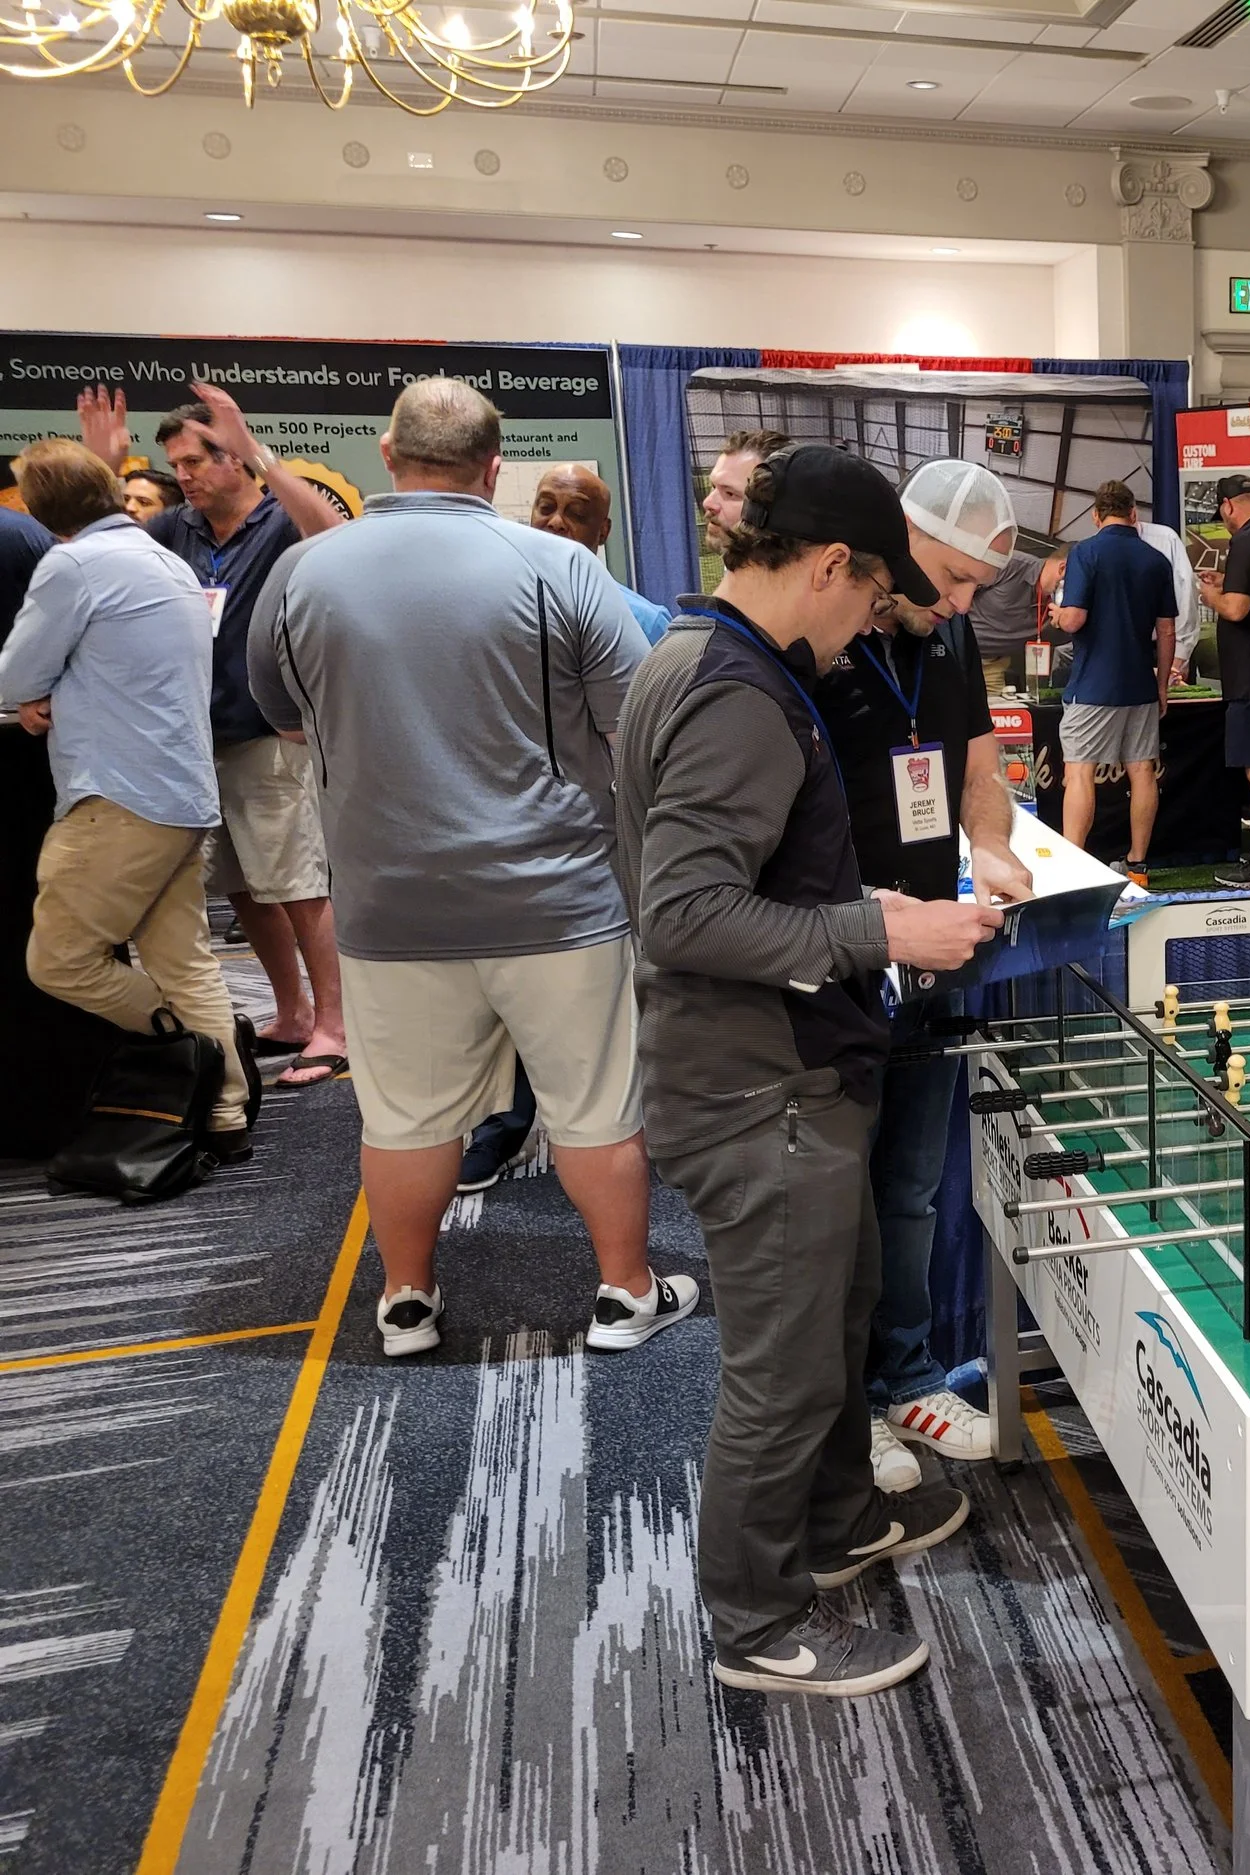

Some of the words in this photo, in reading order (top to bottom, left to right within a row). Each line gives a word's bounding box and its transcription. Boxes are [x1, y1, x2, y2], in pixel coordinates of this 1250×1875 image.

[9, 358, 125, 382] Someone
[128, 361, 186, 383] Who
[191, 362, 342, 386] Understands
[346, 371, 382, 387] our
[498, 370, 599, 396] Beverage
[245, 421, 273, 434] han
[279, 422, 308, 434] 500
[314, 423, 377, 438] Projects
[500, 433, 554, 443] estaurant
[557, 432, 578, 442] and
[268, 441, 330, 456] mpleted
[502, 447, 551, 457] emodels
[1183, 444, 1216, 457] CUSTOM
[910, 798, 936, 809] JEREMY
[912, 806, 936, 817] BRUCE
[1206, 914, 1247, 926] Cascadia
[1063, 1270, 1100, 1346] PRODUCTS
[1136, 1339, 1212, 1500] Cascadia
[1136, 1388, 1166, 1453] SPORT
[1168, 1441, 1213, 1536] SYSTEMS
